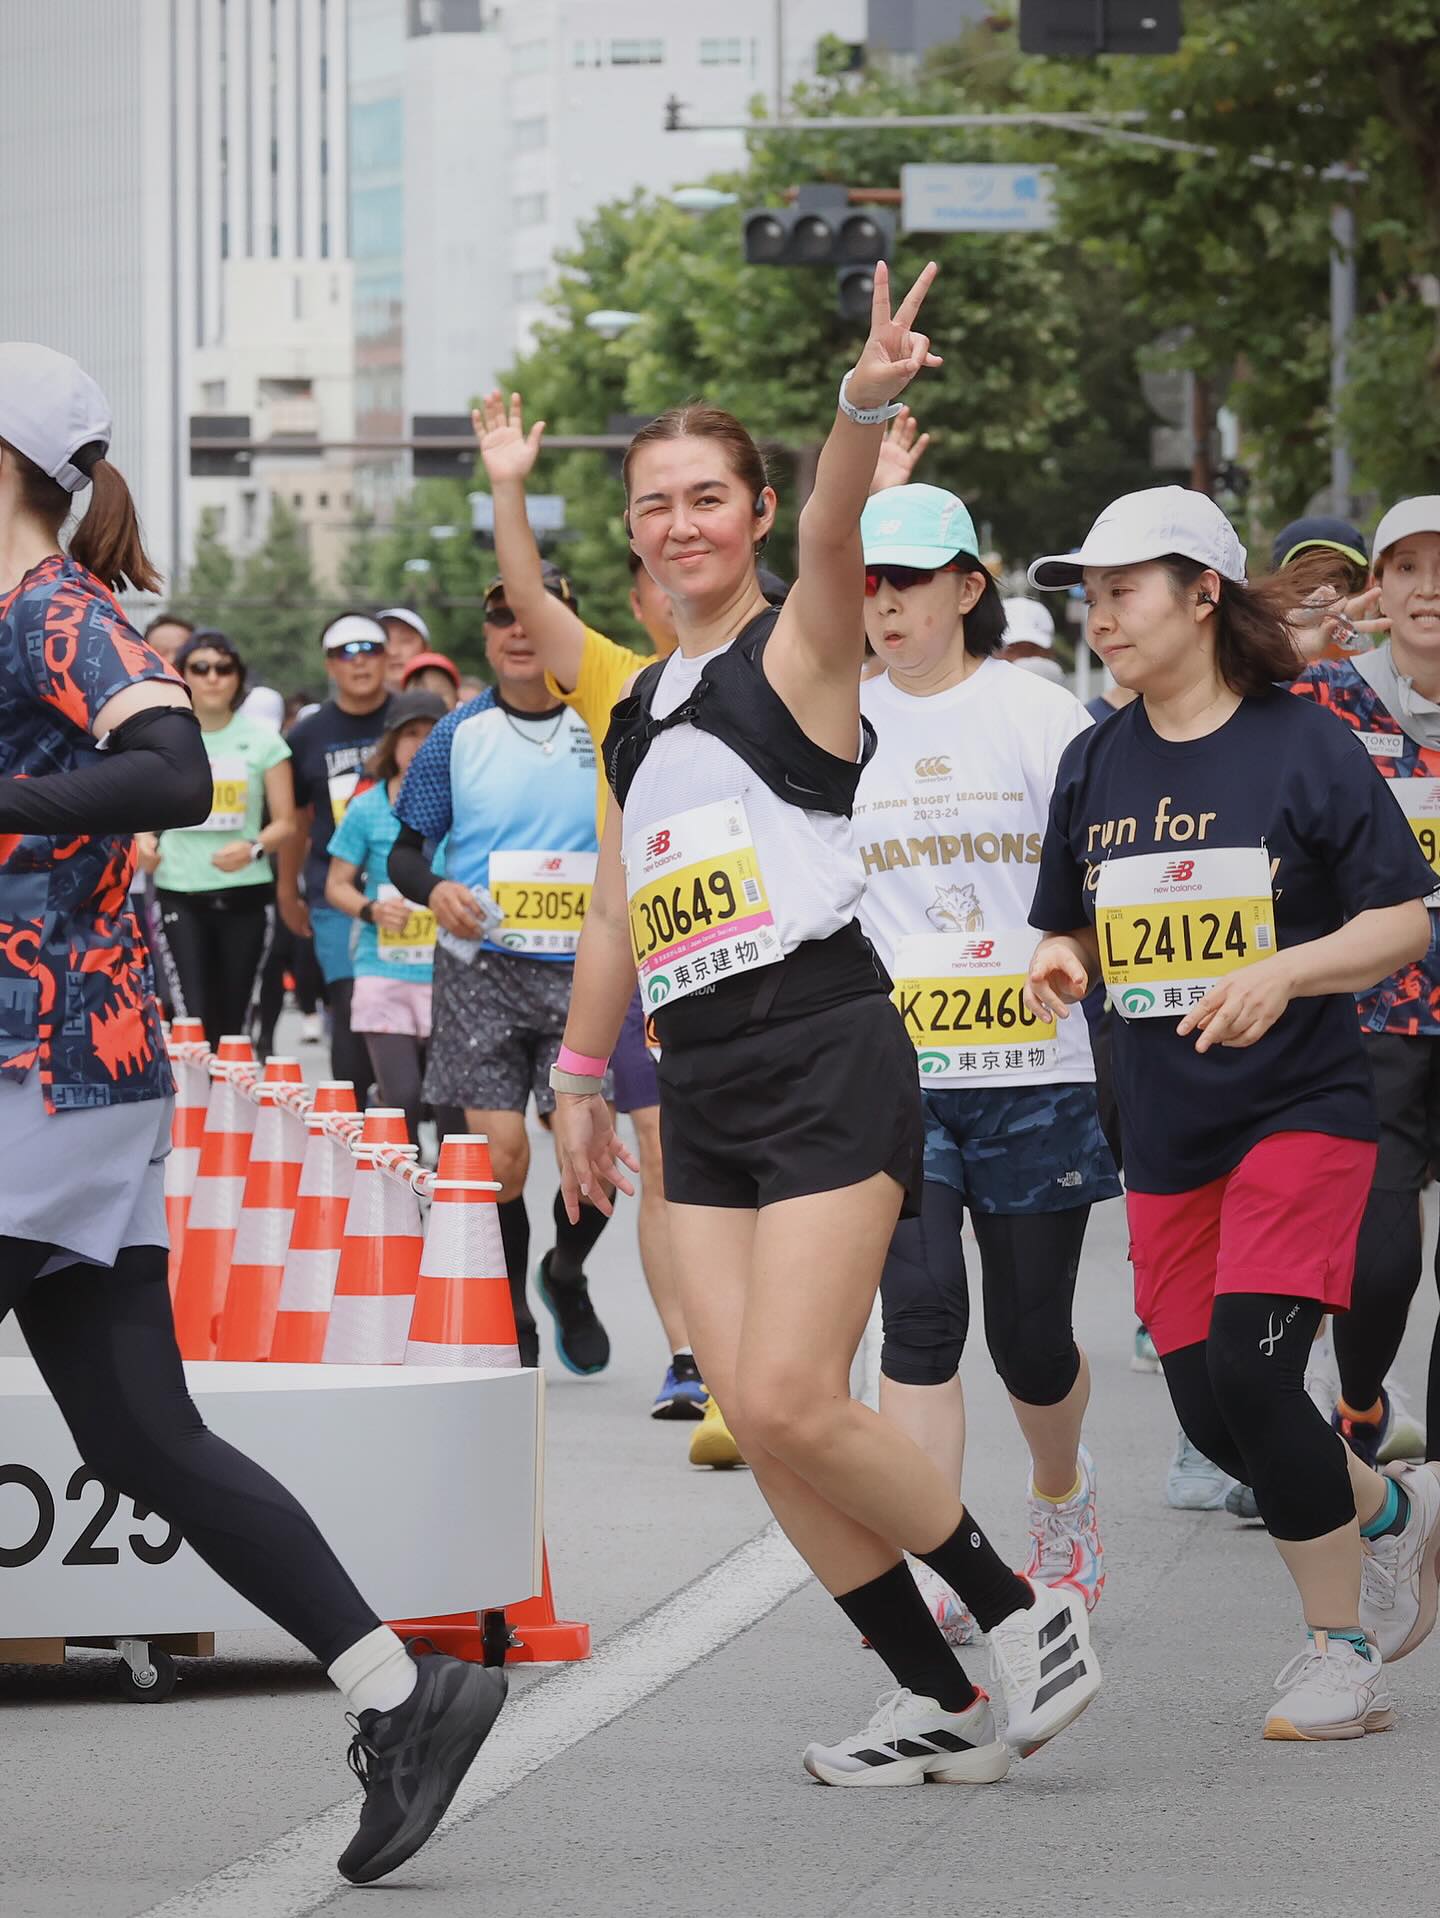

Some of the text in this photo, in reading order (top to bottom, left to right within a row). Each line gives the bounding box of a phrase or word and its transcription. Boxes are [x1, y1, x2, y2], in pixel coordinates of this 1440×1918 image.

[1364, 735, 1401, 748] TOKYO
[872, 798, 908, 812] JAPAN
[912, 793, 951, 807] RUGBY
[956, 791, 998, 802] LEAGUE
[1001, 791, 1025, 802] ONE
[913, 807, 960, 821] 2023-24
[1087, 795, 1217, 853] run for
[858, 831, 1042, 876] HAMPIONS
[1153, 884, 1203, 894] new balance
[630, 870, 737, 961] L30649
[1105, 910, 1247, 968] L24124
[673, 940, 760, 990] 東京建物
[951, 960, 1001, 969] new balance
[958, 1047, 1046, 1071] 東京建物
